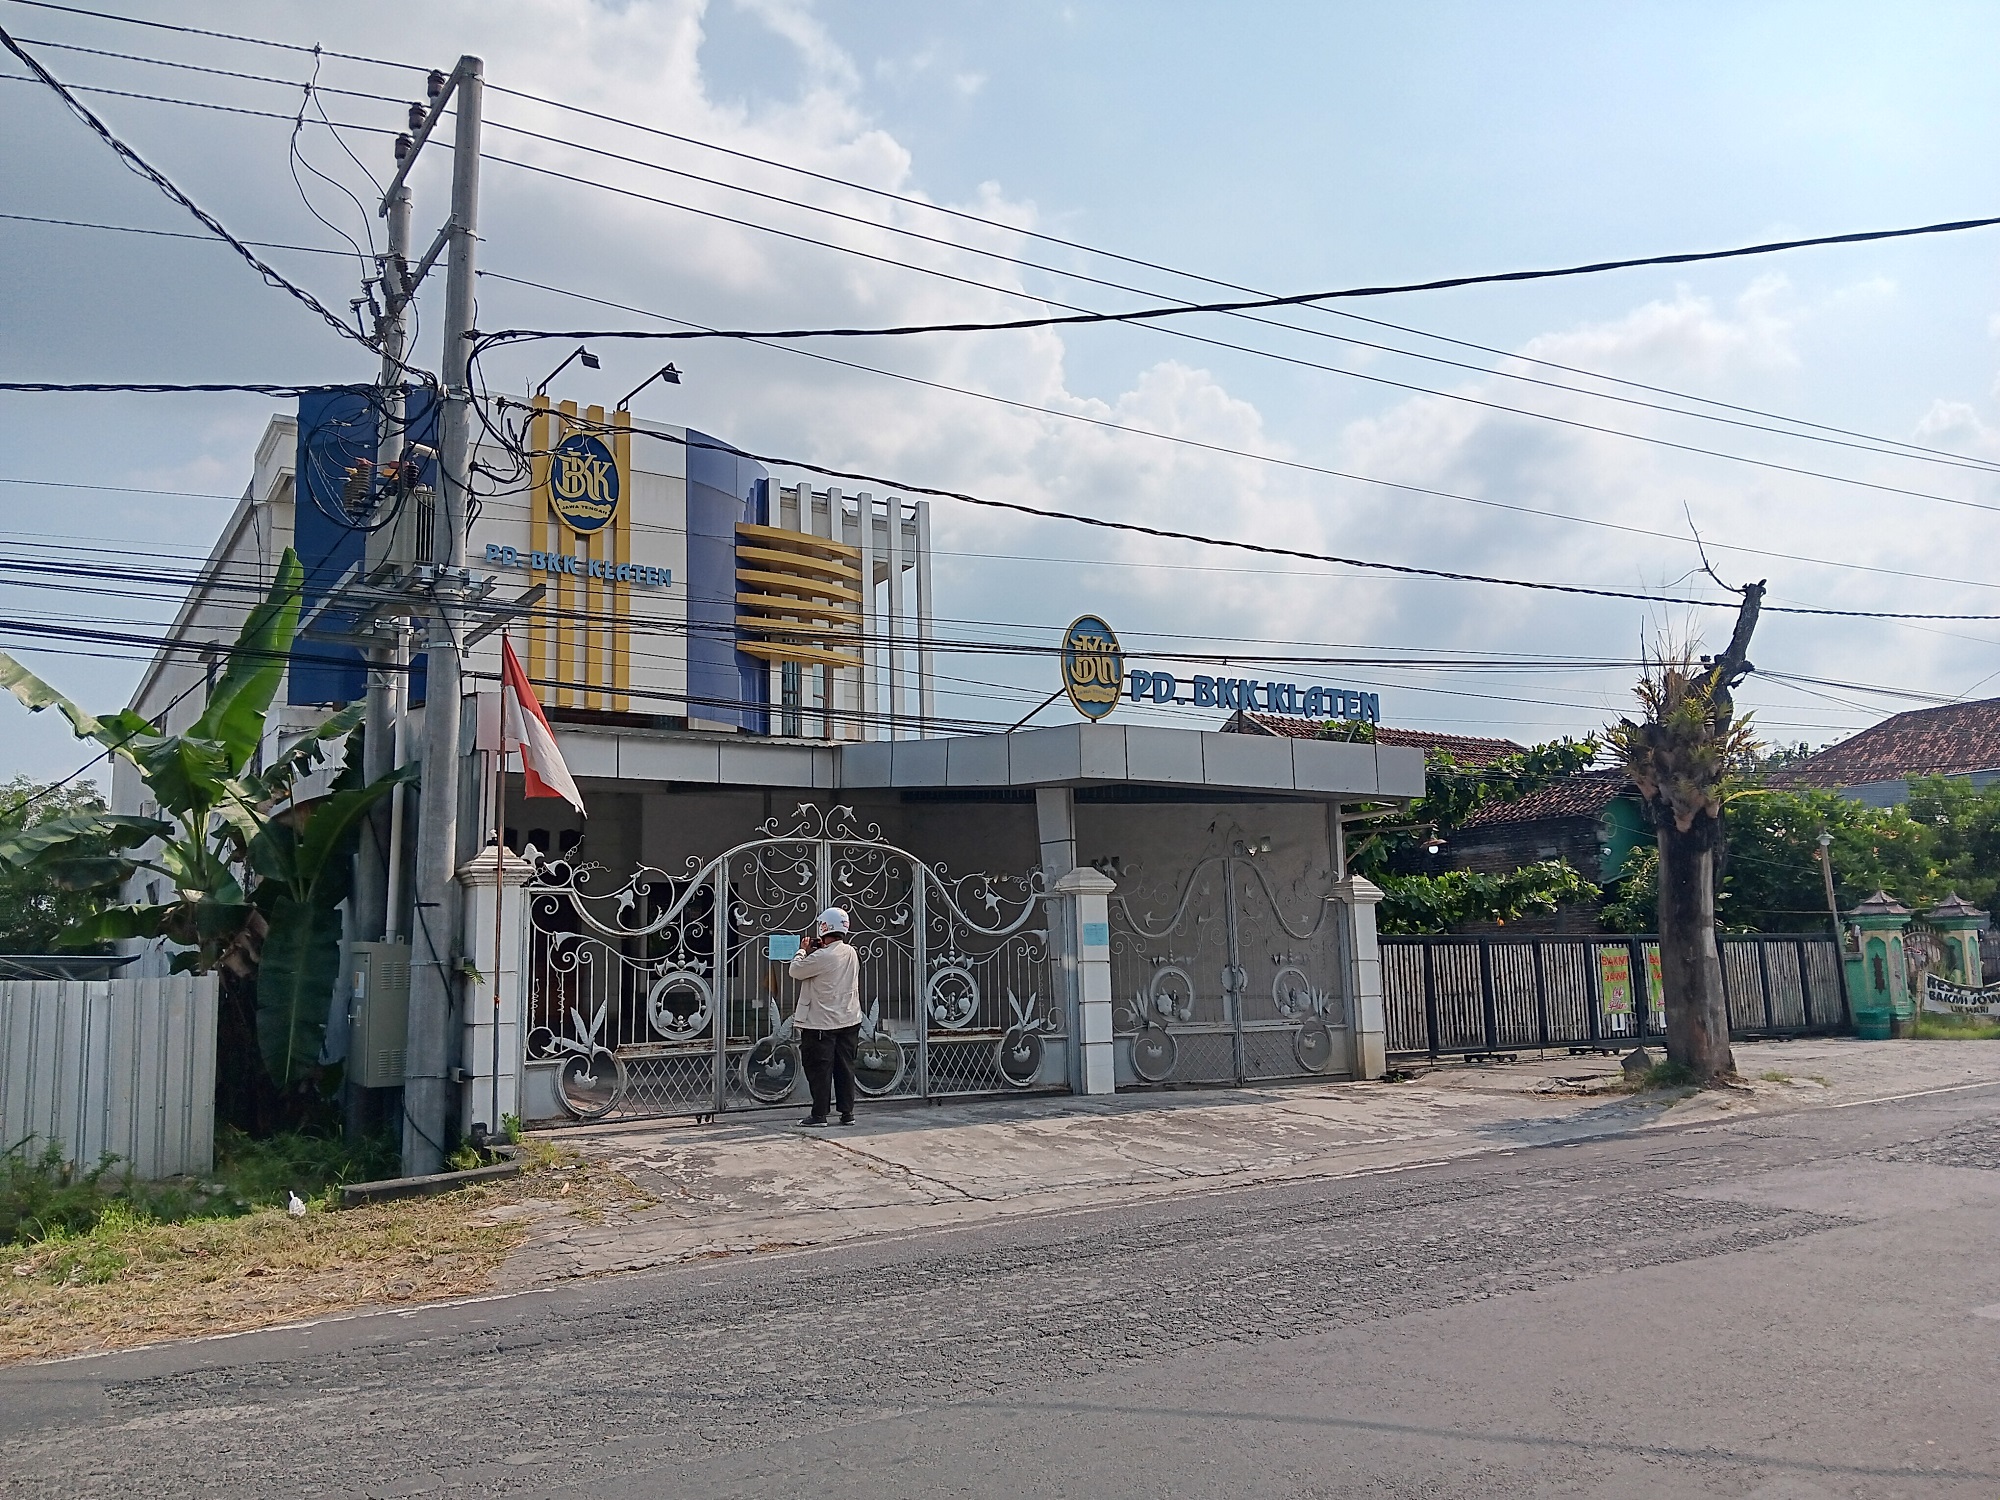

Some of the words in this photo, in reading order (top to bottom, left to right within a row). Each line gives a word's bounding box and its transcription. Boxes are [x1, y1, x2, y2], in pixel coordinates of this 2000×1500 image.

[486, 543, 523, 568] PD.
[531, 550, 578, 575] BKK
[588, 558, 672, 588] KLATEN
[1131, 669, 1186, 705] PD.
[1193, 674, 1260, 712] BKK
[1266, 682, 1381, 723] KLATEN
[1928, 990, 1968, 1005] BAKMI
